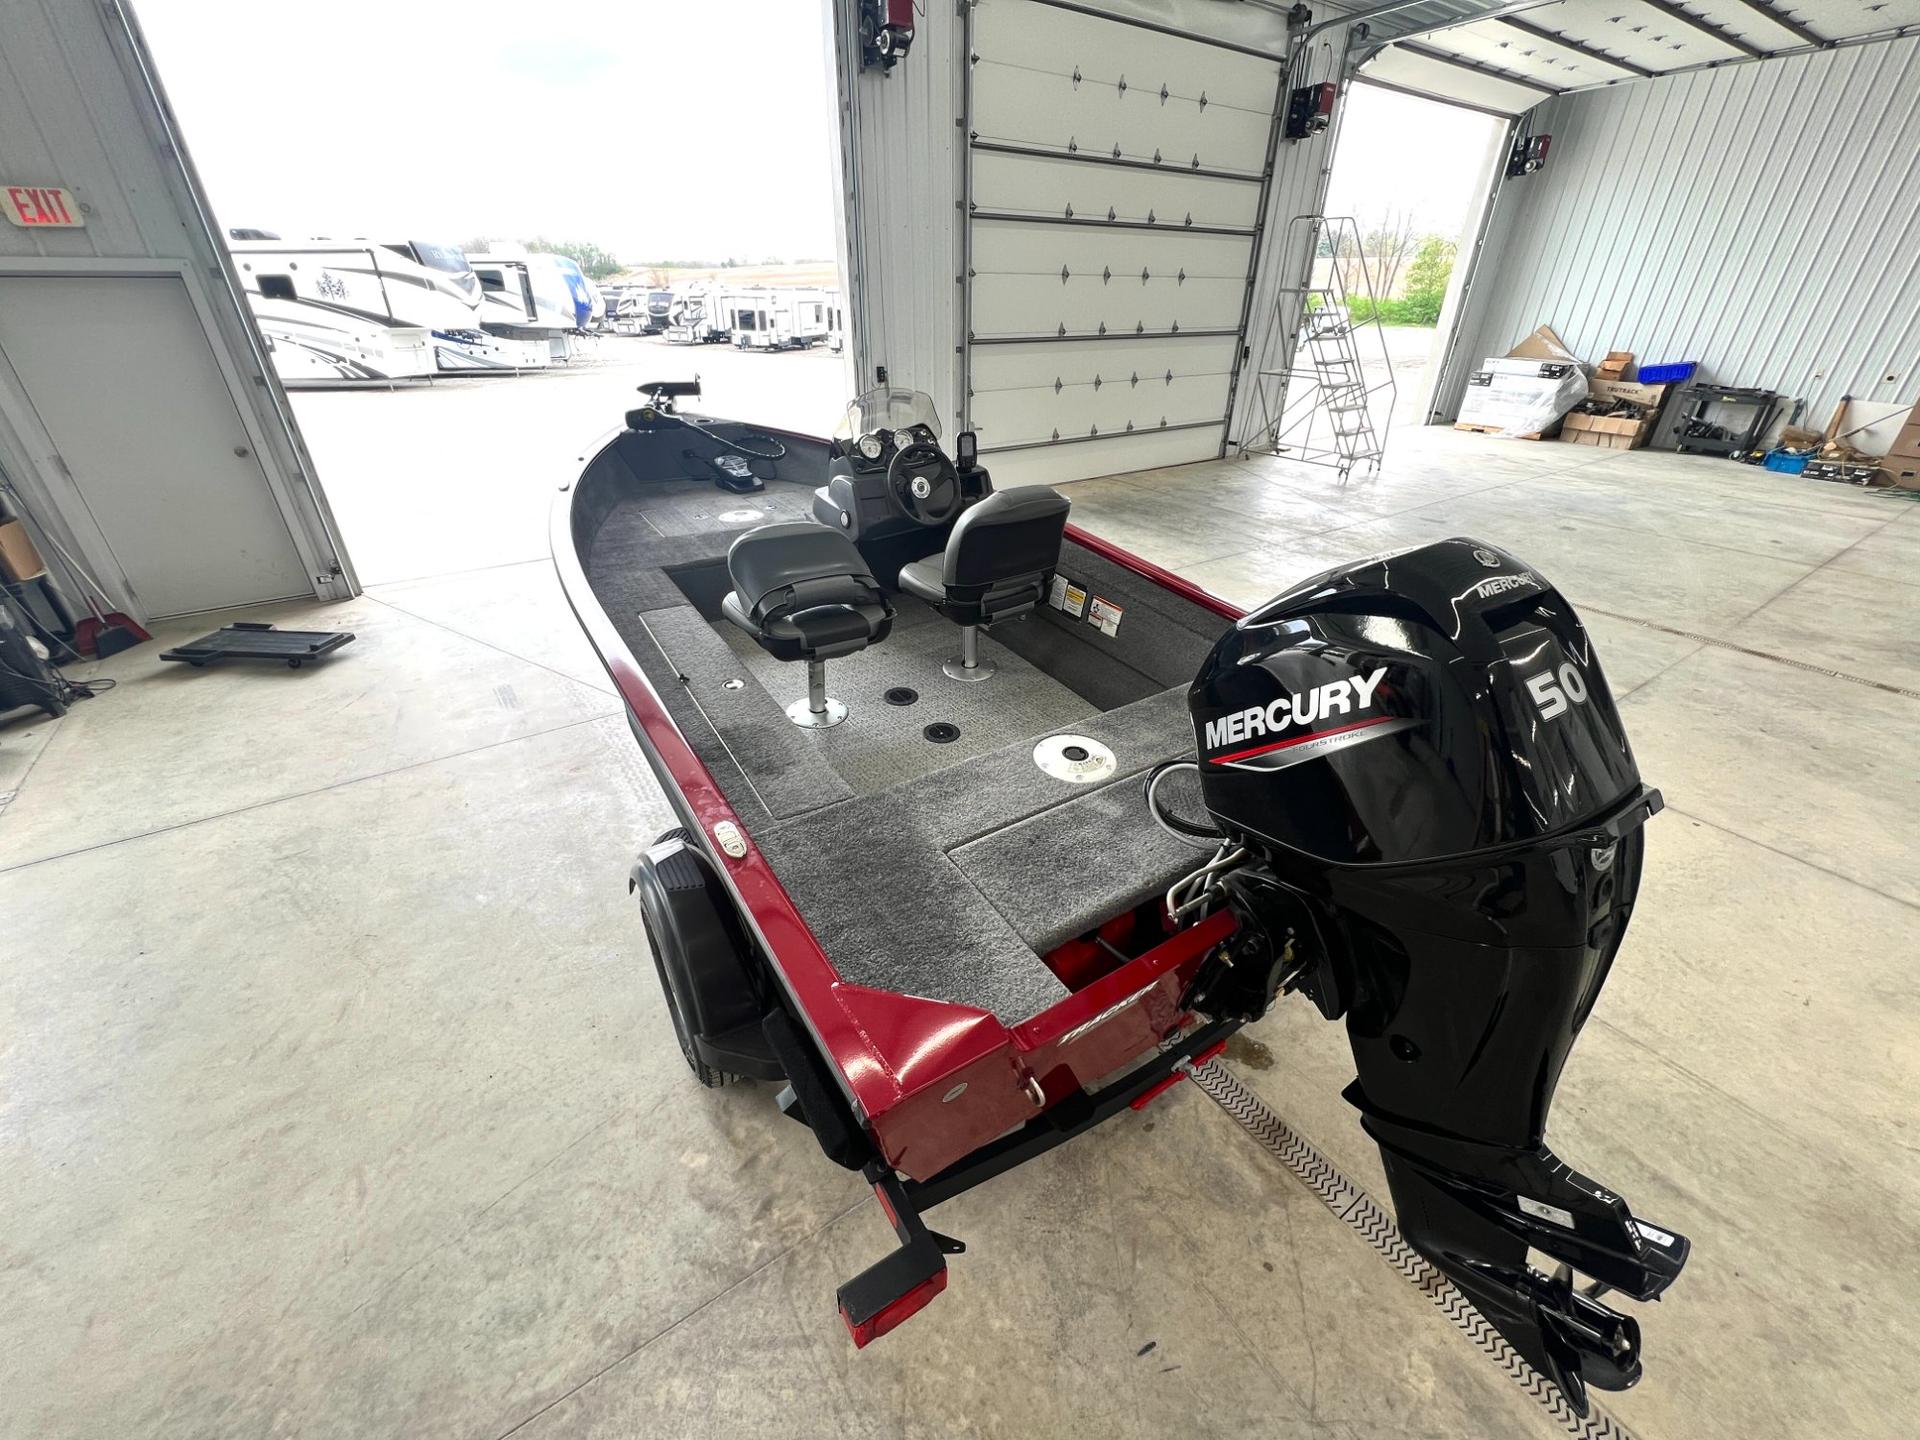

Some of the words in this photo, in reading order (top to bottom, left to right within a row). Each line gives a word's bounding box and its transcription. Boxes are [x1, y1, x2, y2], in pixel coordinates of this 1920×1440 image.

[7, 188, 72, 224] EXIT
[1477, 571, 1536, 599] MERCURY
[1205, 667, 1387, 750] MERCURY
[1524, 661, 1588, 722] 50
